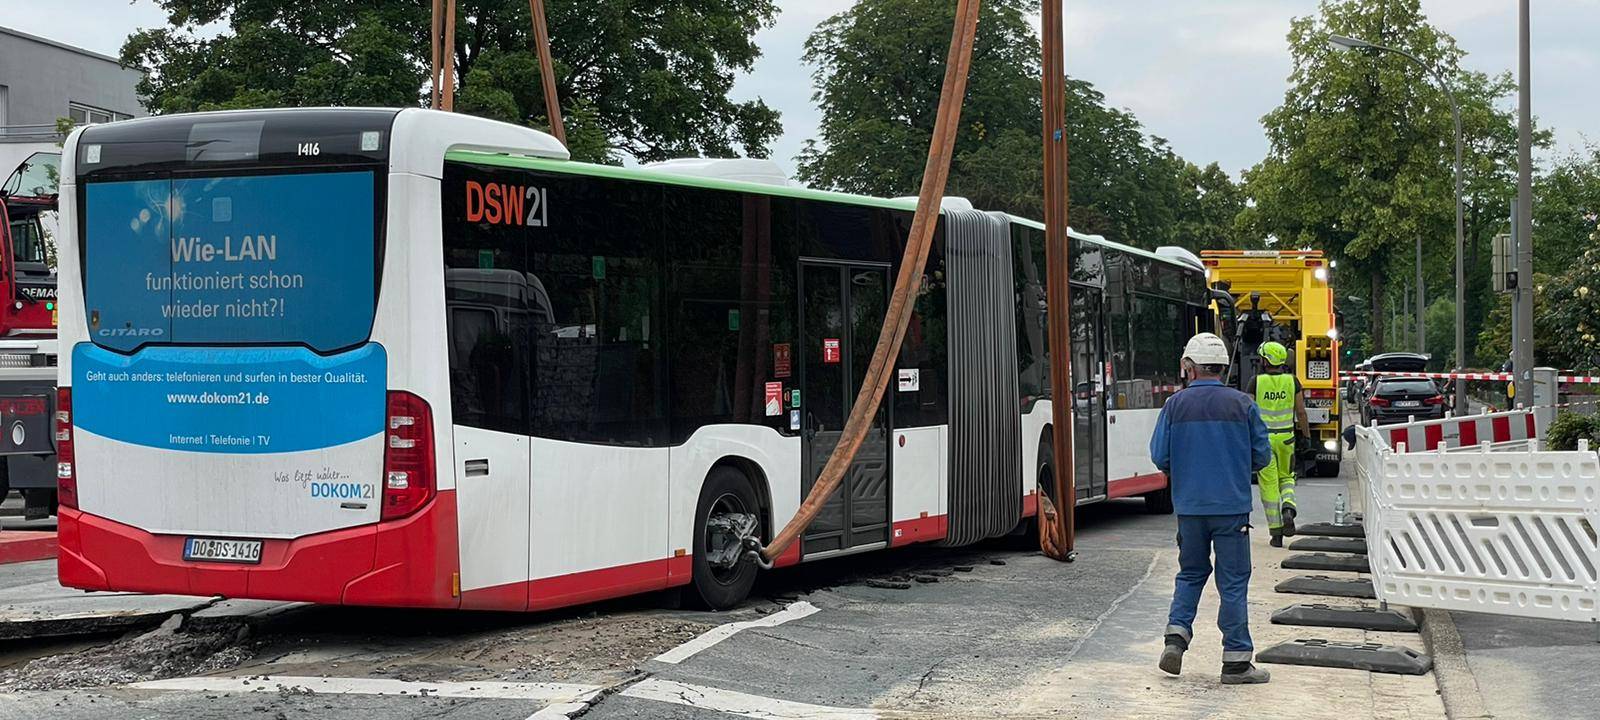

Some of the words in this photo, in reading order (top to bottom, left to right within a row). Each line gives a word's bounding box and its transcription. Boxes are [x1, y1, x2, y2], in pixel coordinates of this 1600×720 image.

[298, 143, 320, 156] 1416
[466, 181, 548, 228] DSW21
[171, 235, 277, 262] Wie-LAN
[146, 271, 244, 291] funktioniert
[249, 270, 304, 289] schon
[161, 299, 220, 318] wieder
[225, 298, 285, 318] nicht?!
[99, 328, 164, 337] CITARO
[86, 371, 106, 382] Geht
[108, 371, 129, 382] auch
[131, 371, 164, 383] anders:
[166, 371, 221, 383] telefonieren
[223, 372, 242, 383] und
[244, 372, 276, 383] surfen
[278, 372, 288, 383] in
[290, 372, 322, 383] bester
[324, 371, 368, 384] Qualität.
[167, 391, 270, 405] www.dokom21.de
[1264, 391, 1287, 400] ADAC
[169, 434, 203, 445] Internet
[210, 434, 250, 446] Telefonie
[257, 435, 271, 446] TV
[311, 482, 375, 499] DOKOM21
